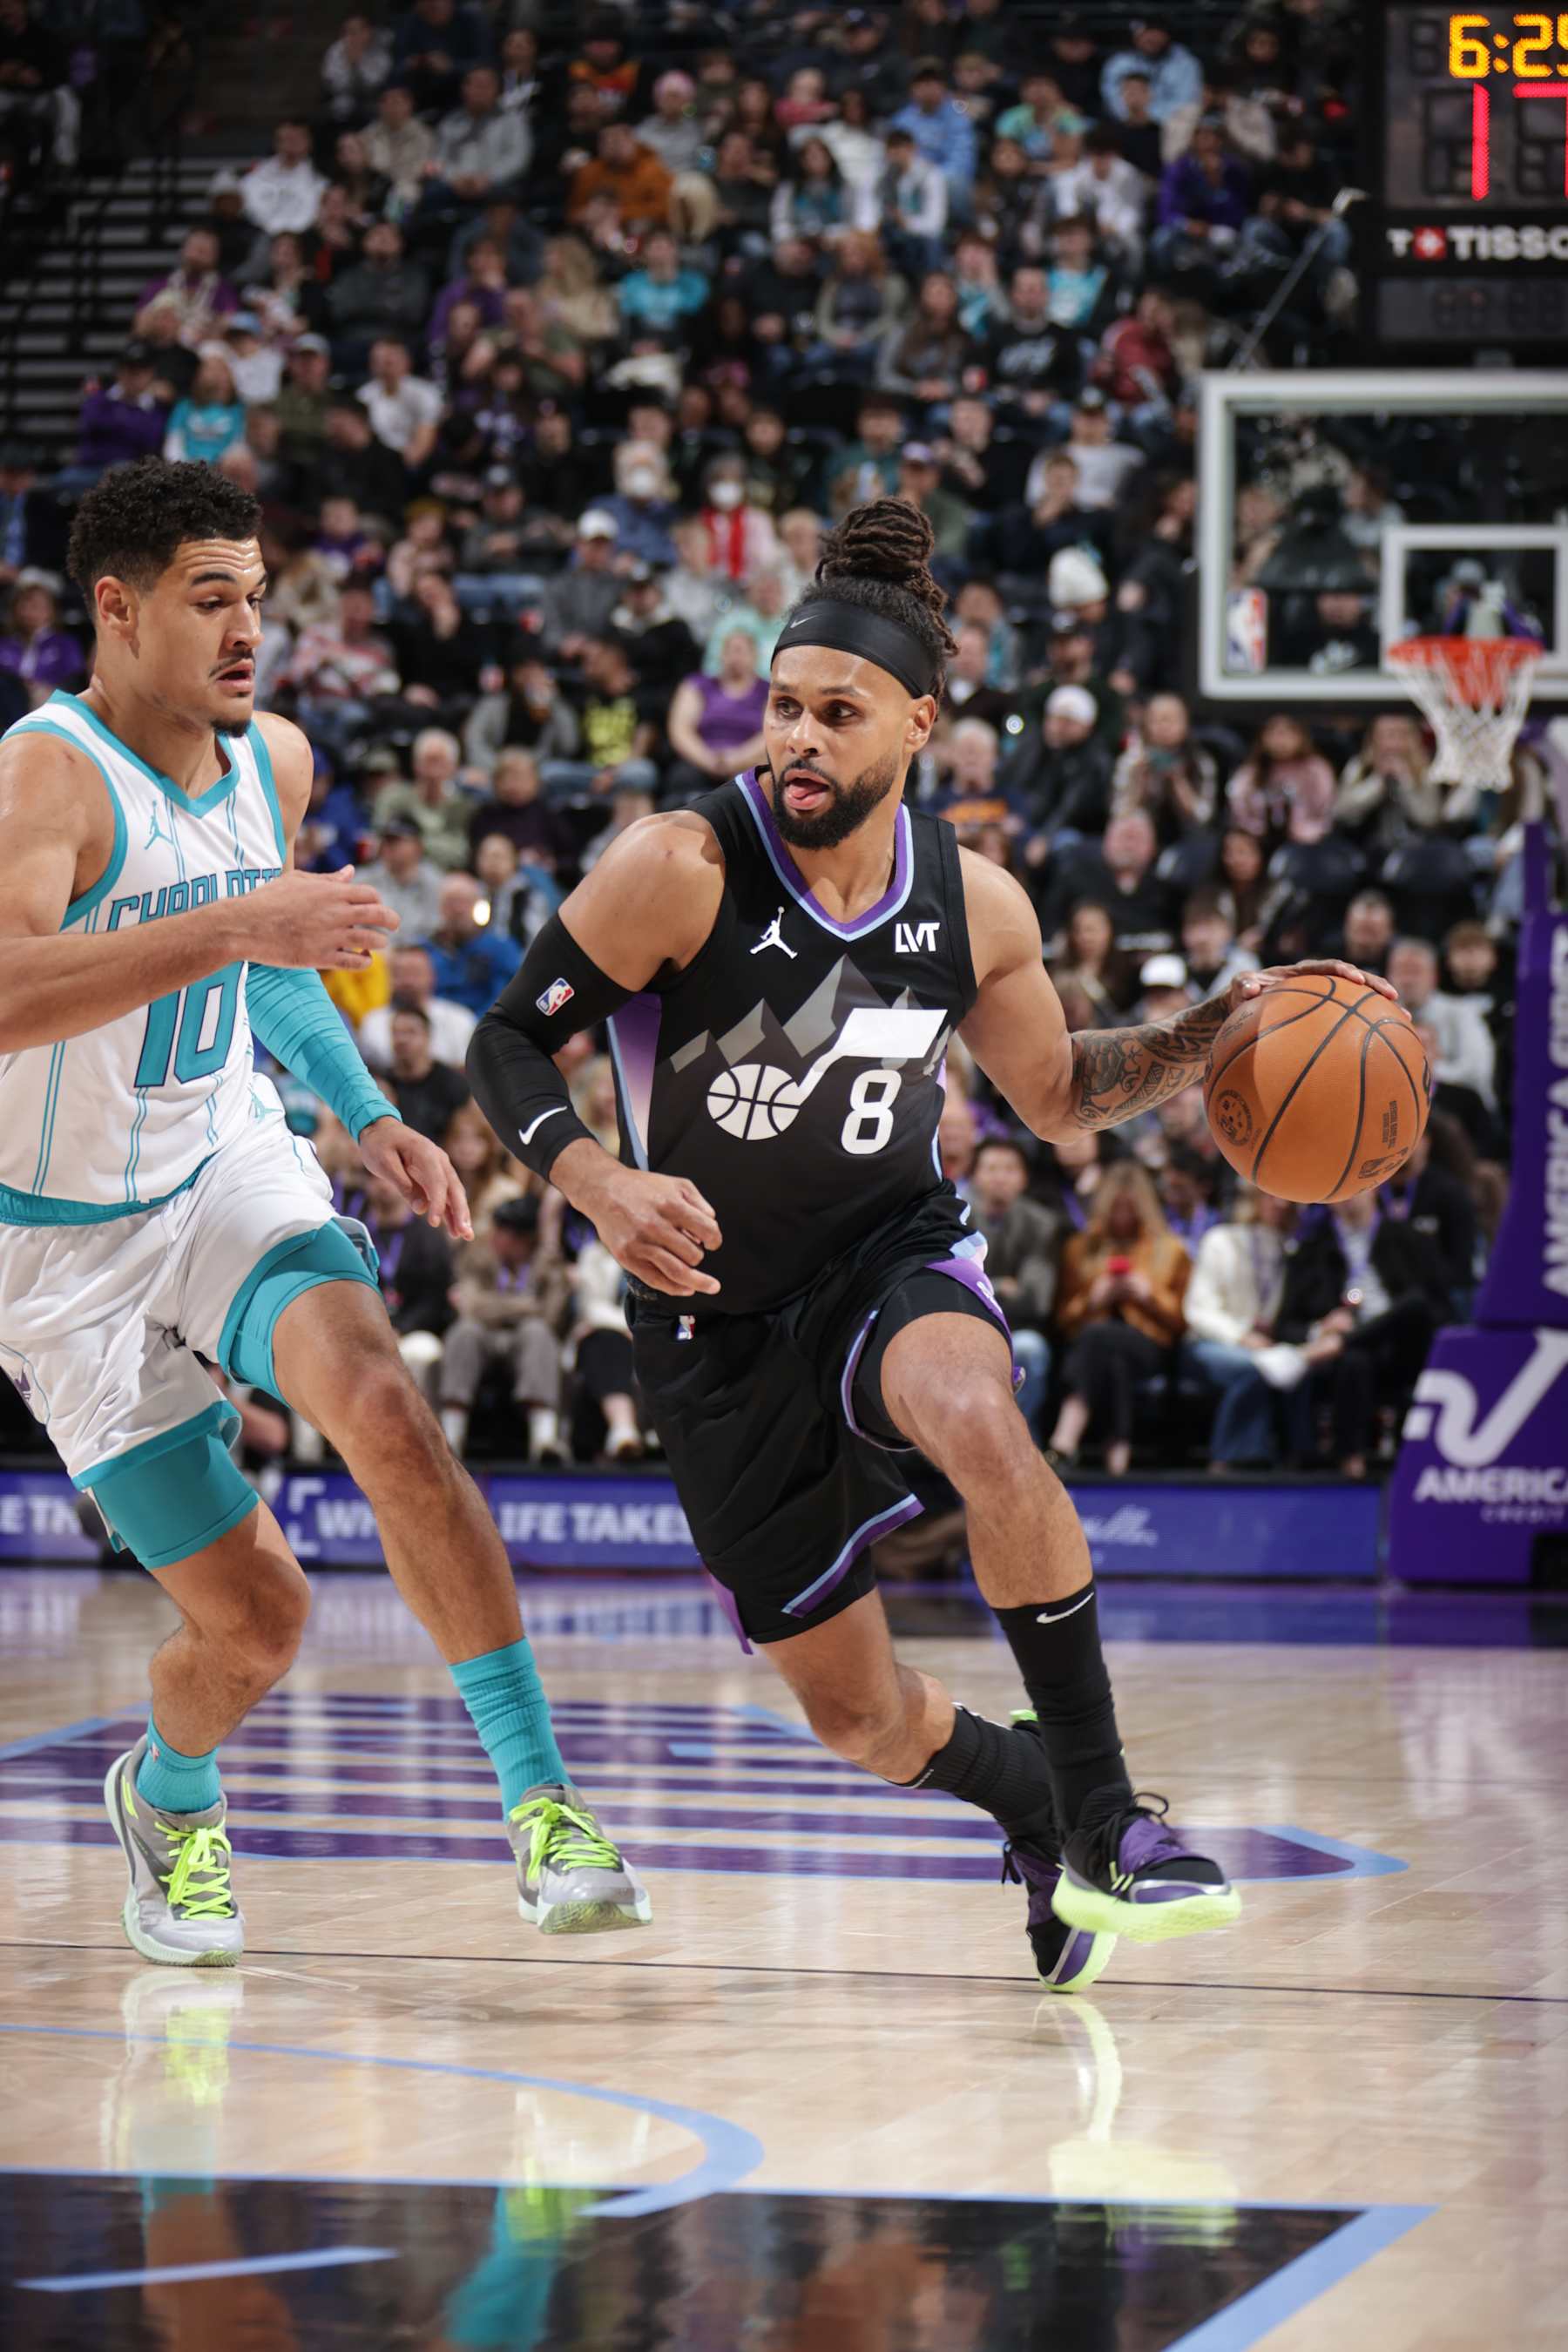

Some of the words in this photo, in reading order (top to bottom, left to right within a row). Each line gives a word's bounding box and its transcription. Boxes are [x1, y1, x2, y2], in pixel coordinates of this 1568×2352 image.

[895, 922, 941, 953] LVT
[134, 960, 247, 1088] 10
[841, 1069, 902, 1155] 8
[1413, 1464, 1568, 1505] AMERIC
[500, 1501, 566, 1543] IFE
